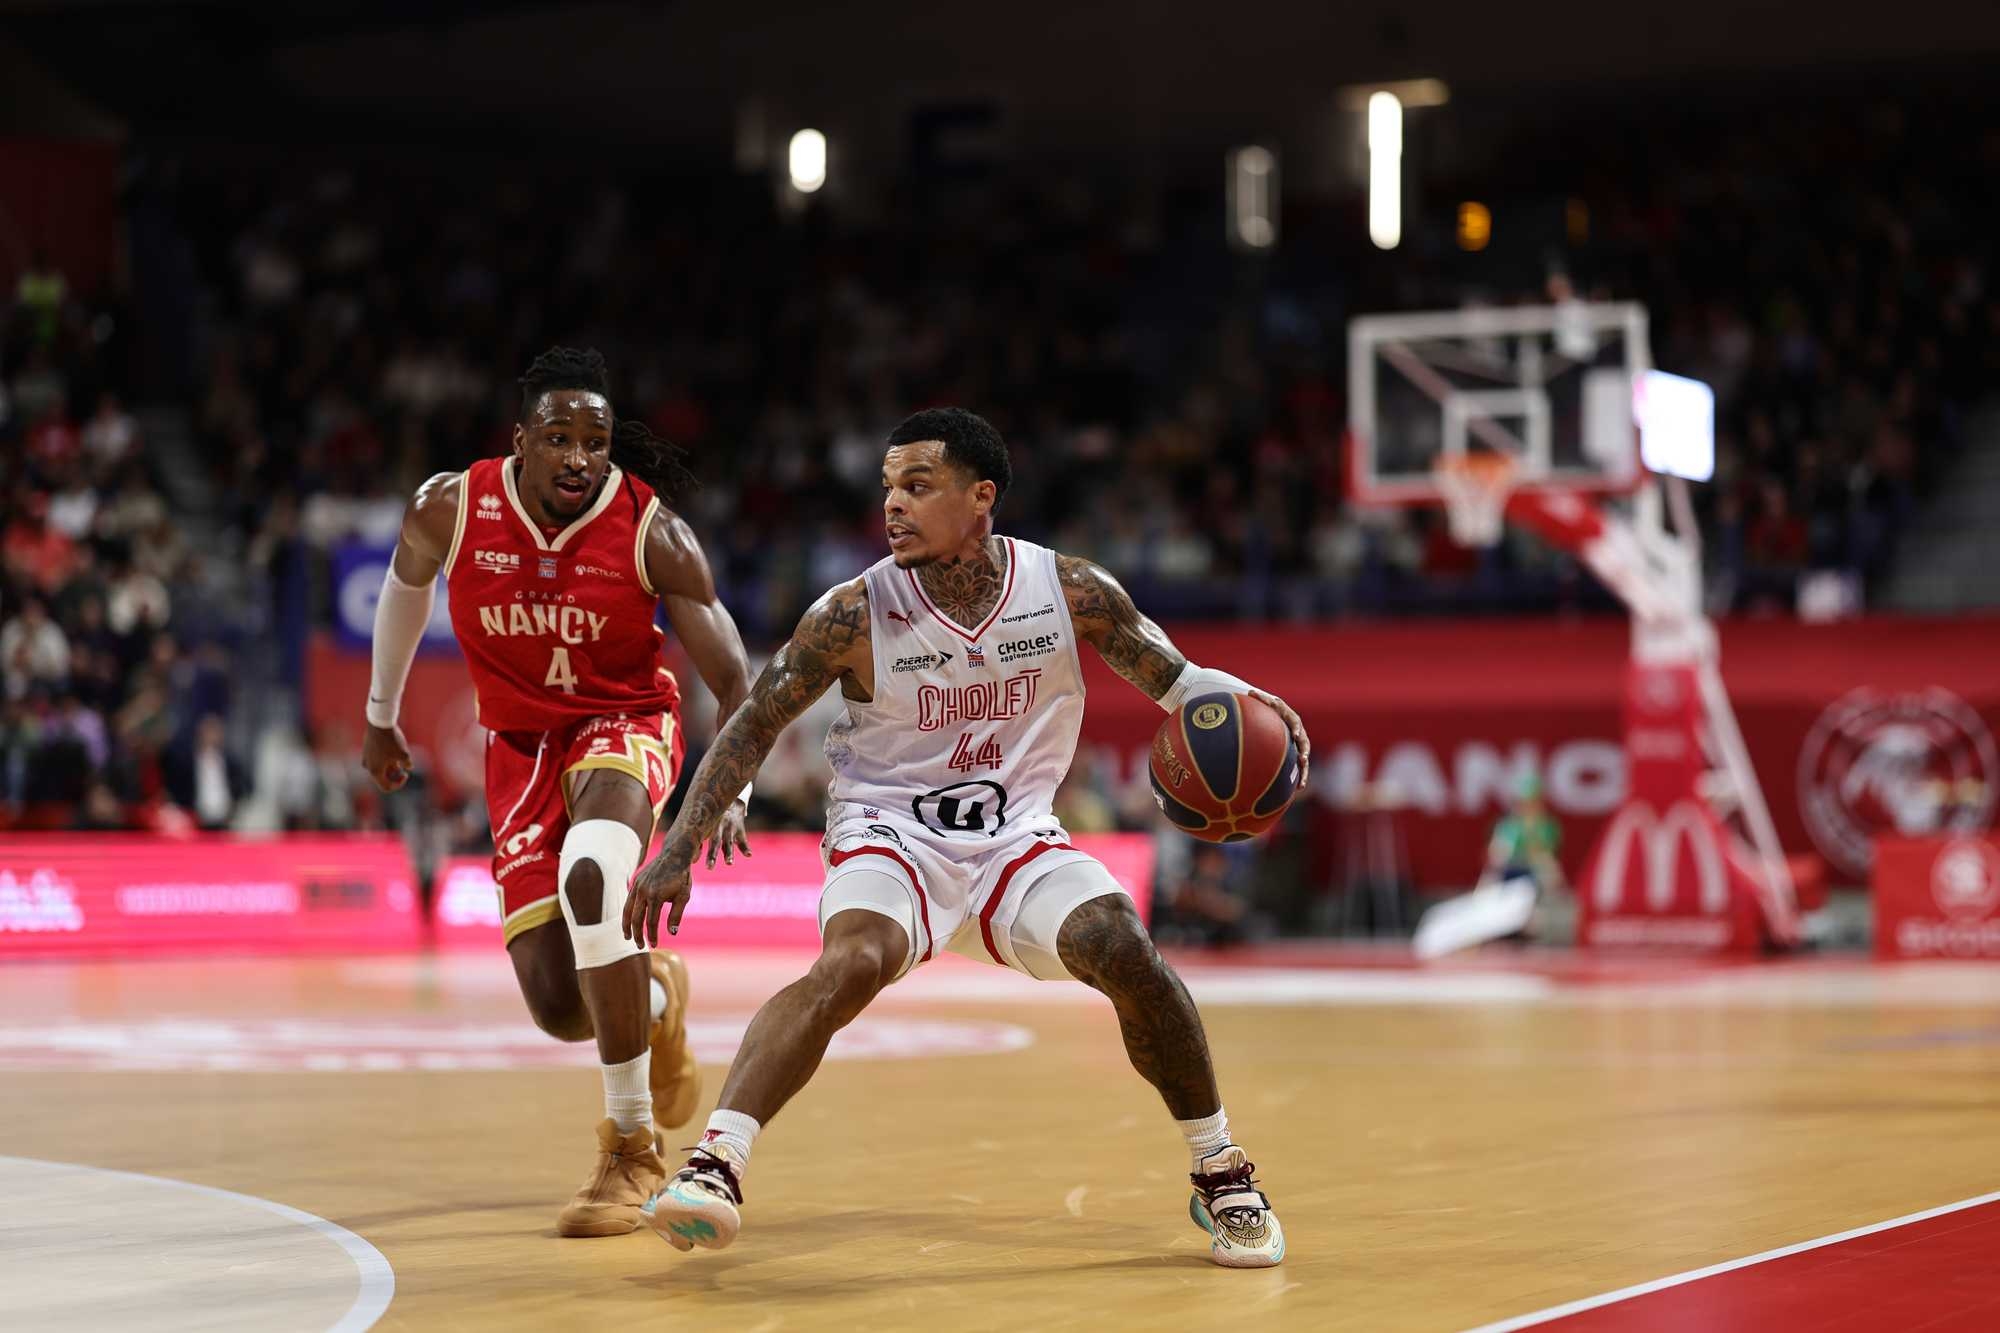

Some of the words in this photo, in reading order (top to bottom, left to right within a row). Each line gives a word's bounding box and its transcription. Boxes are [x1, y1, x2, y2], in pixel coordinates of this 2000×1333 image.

[475, 550, 520, 565] FCGE
[515, 590, 575, 604] GRAND
[479, 603, 608, 645] NANCY
[544, 647, 578, 695] 4
[891, 663, 930, 672] Transports
[917, 668, 1042, 732] CHOLET
[947, 732, 1003, 773] 44
